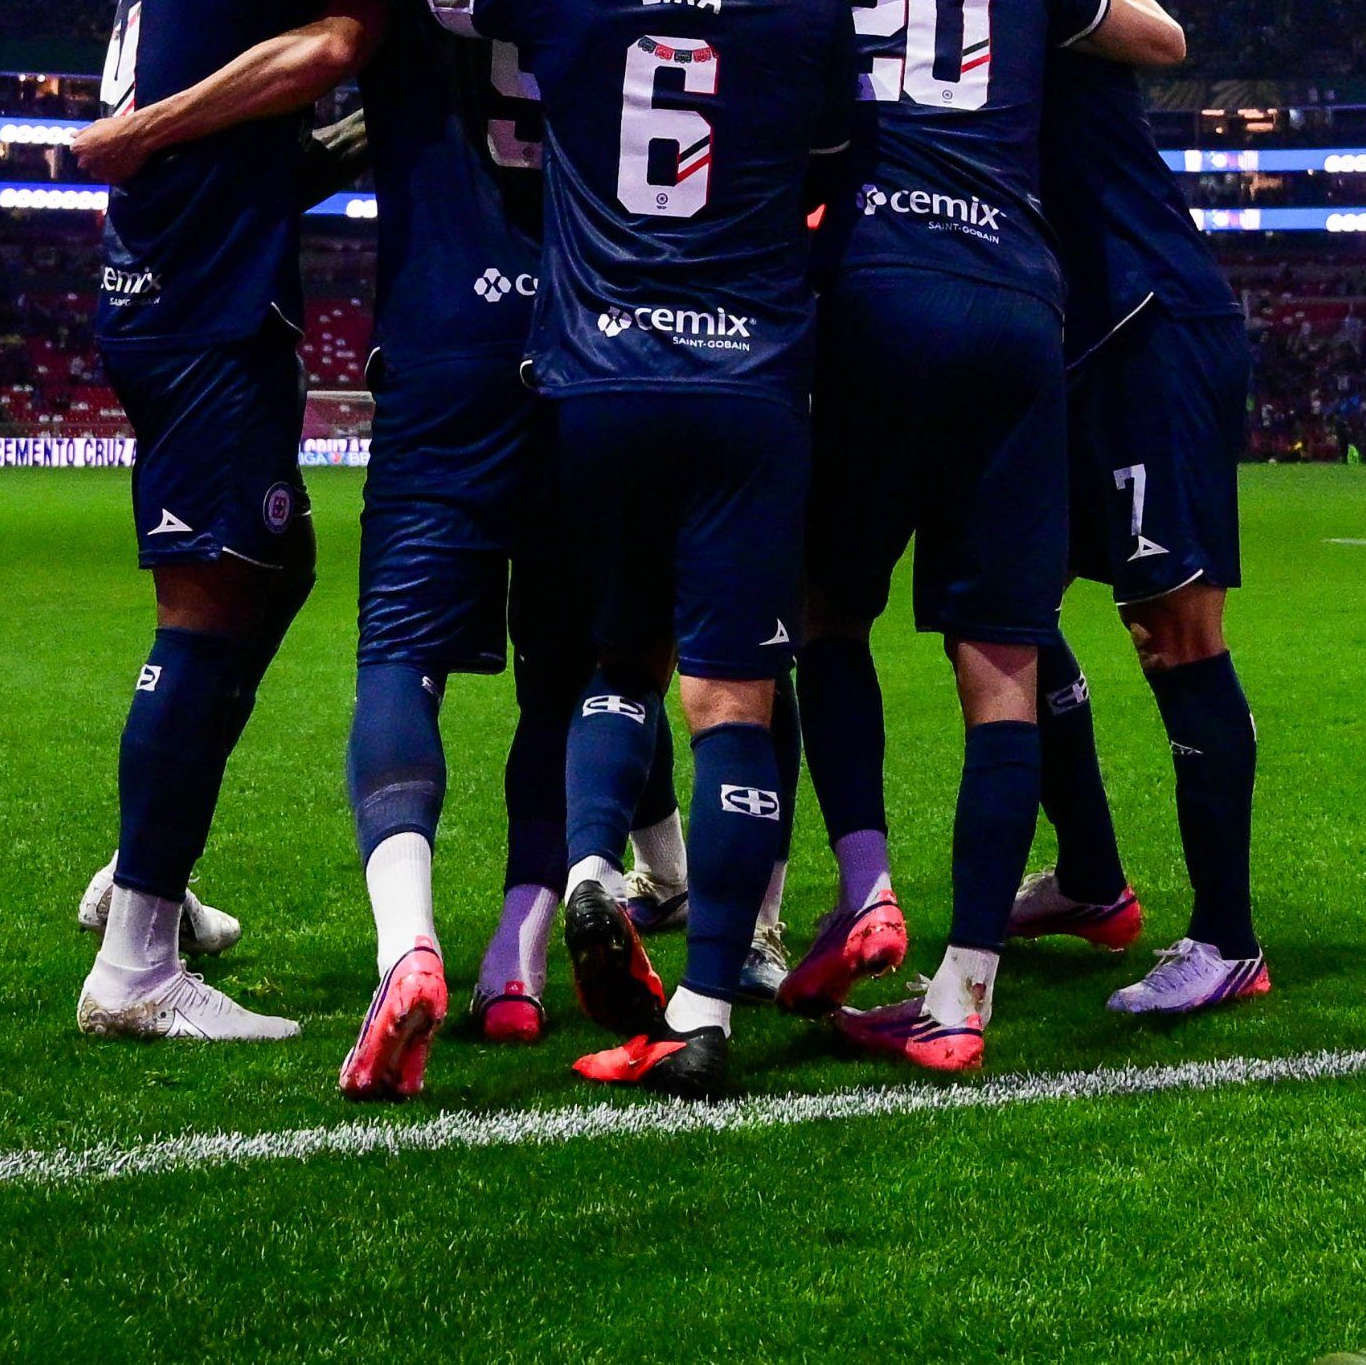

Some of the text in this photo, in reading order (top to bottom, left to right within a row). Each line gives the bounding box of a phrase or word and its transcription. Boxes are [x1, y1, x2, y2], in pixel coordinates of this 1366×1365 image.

[617, 35, 718, 218] 6
[891, 190, 1000, 230] cemix
[928, 221, 1000, 245] SAINT-GOBAIN
[101, 266, 162, 294] emix
[635, 307, 751, 338] cemix
[672, 336, 751, 352] SAINT-GOBAIN
[83, 438, 125, 467] CRUZ
[1113, 463, 1146, 537] 7
